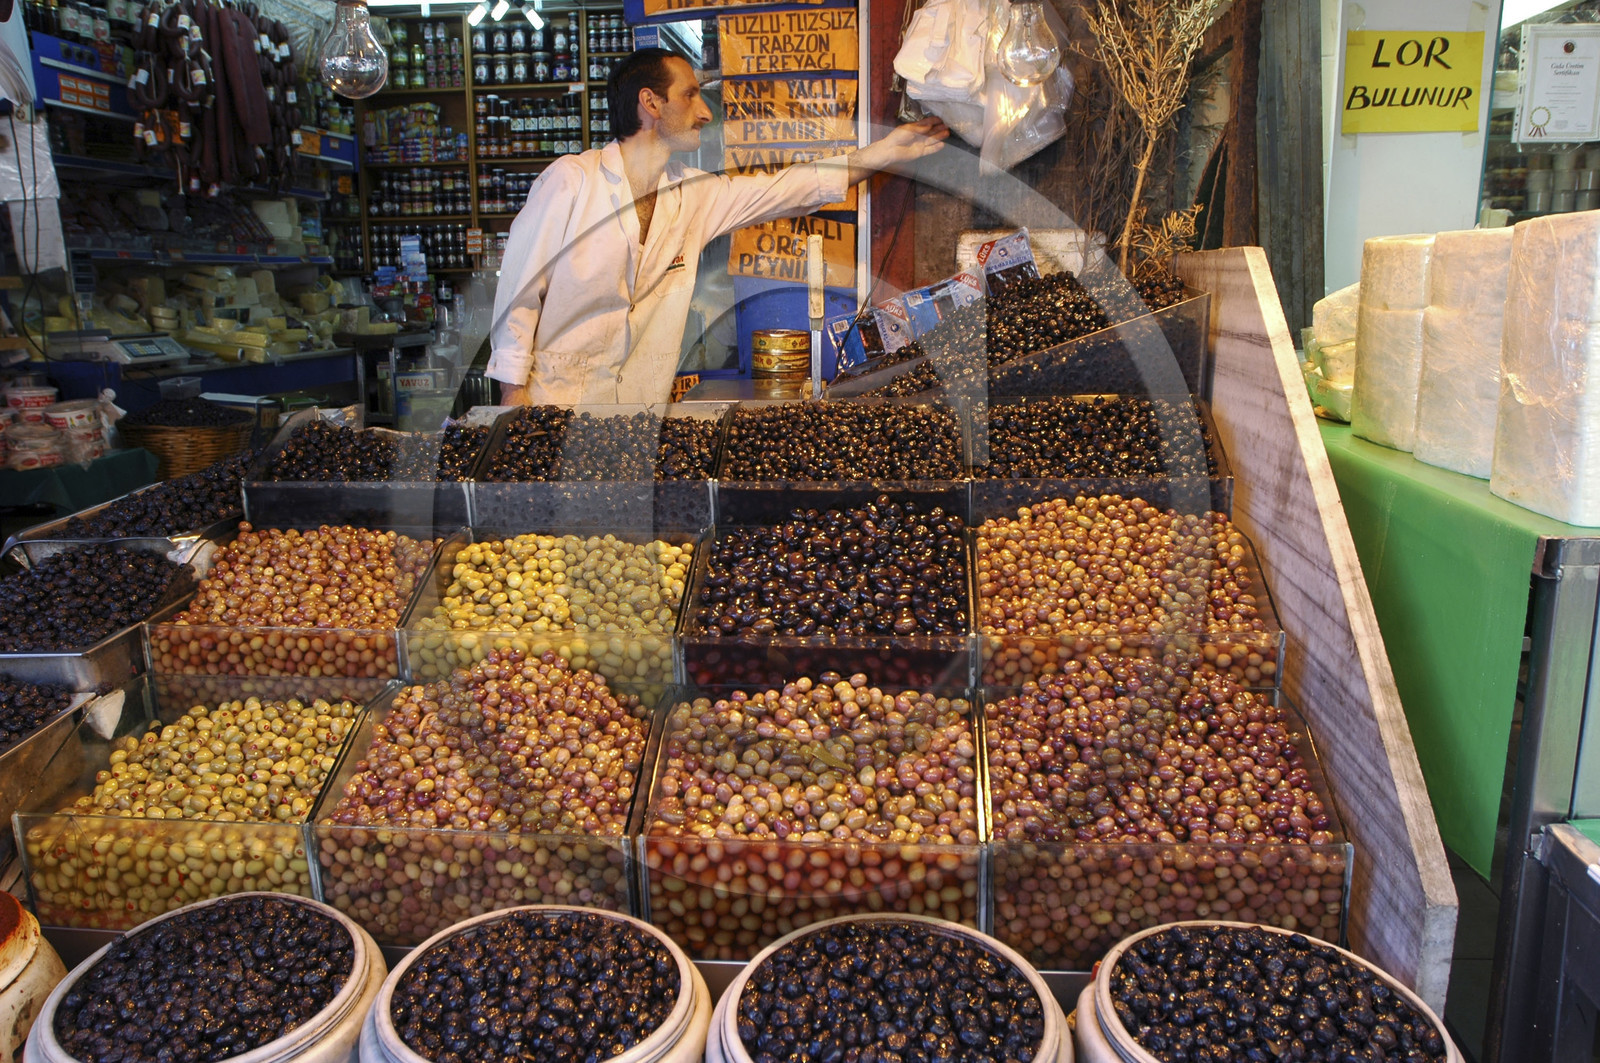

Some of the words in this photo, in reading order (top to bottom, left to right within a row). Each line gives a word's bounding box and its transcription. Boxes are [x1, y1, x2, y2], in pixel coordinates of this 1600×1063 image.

[746, 33, 829, 54] TRABZON
[1371, 37, 1452, 69] LOR
[730, 80, 775, 99] TAM
[1345, 86, 1472, 110] BULUNUR
[731, 150, 785, 174] VAN
